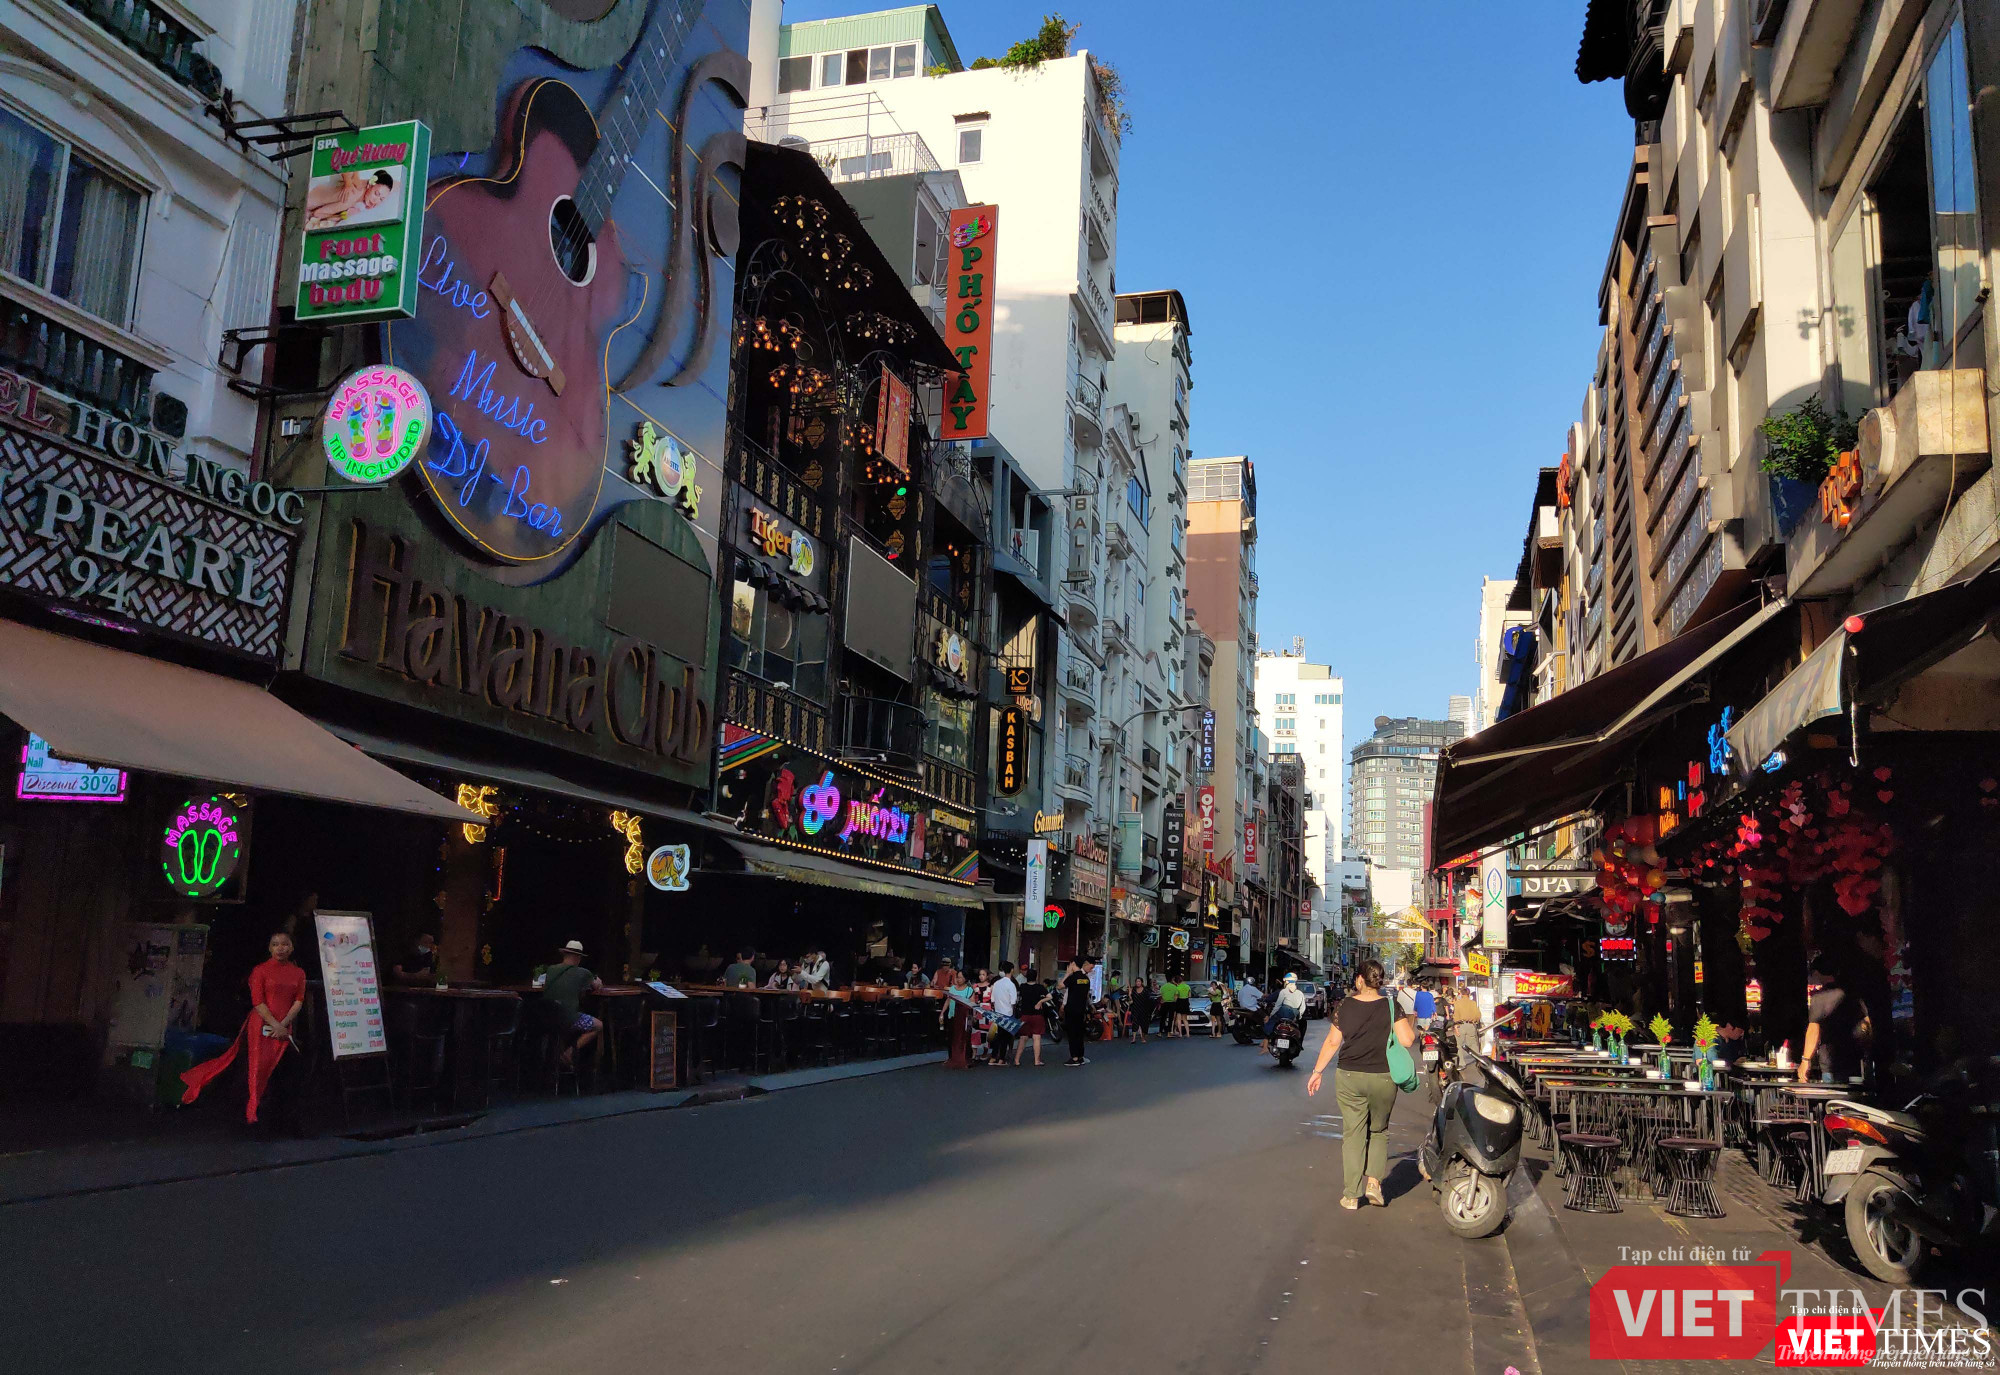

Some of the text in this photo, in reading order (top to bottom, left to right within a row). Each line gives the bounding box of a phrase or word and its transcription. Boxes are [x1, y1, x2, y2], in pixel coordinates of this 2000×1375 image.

[317, 138, 338, 150] SPA
[320, 233, 384, 260] Foot
[418, 236, 490, 318] Live
[951, 247, 982, 430] PHỐ TÂY
[331, 371, 420, 421] MASSAGE
[450, 350, 547, 443] Music
[328, 419, 422, 479] TIP INCLUDED
[35, 481, 271, 609] PEARL
[751, 507, 792, 556] Tiger
[1073, 498, 1087, 567] BALI
[69, 555, 129, 613] 94
[27, 757, 44, 769] Nail
[1004, 711, 1016, 788] KASBAH
[1203, 711, 1214, 767] SMALL BAY
[26, 774, 117, 792] Discount 30%
[800, 770, 840, 835] 86
[165, 803, 238, 847] MASSAGE
[1201, 793, 1213, 829] OYO
[1165, 821, 1180, 885] HOTEL
[1246, 828, 1255, 852] OYO
[1525, 864, 1573, 892] SPA
[1181, 917, 1197, 926] Spa
[1473, 963, 1486, 974] 4G
[1528, 975, 1559, 984] SALE
